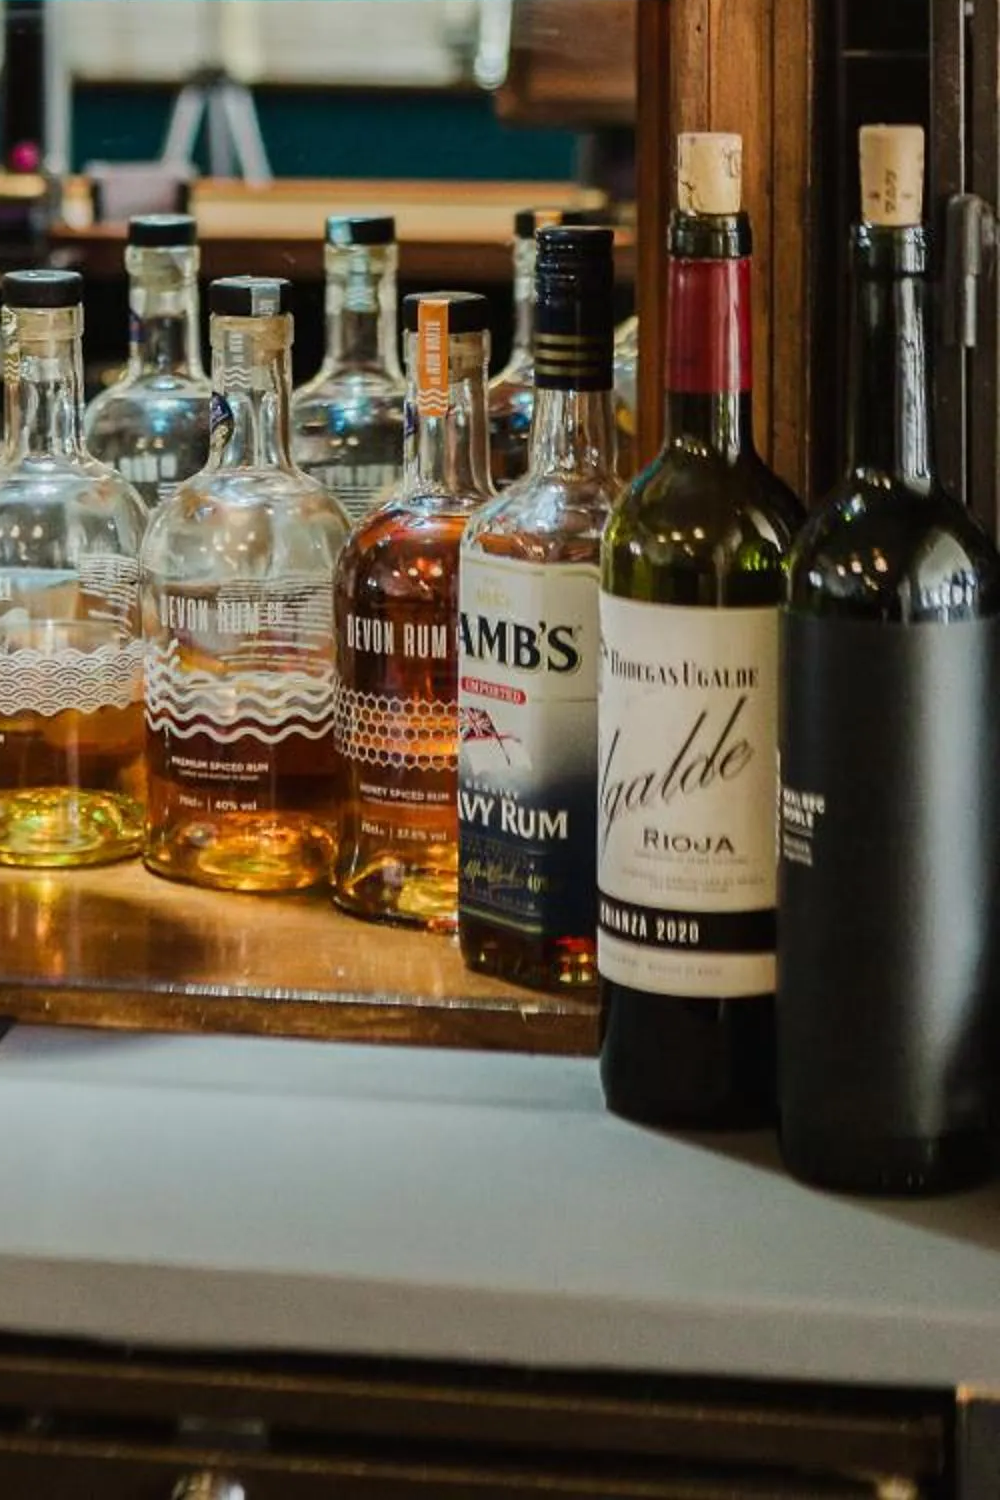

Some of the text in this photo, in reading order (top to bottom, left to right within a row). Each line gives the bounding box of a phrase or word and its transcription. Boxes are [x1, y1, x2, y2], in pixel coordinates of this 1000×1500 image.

[160, 595, 210, 632] DEVON
[347, 613, 448, 659] DEVON RUM
[459, 611, 579, 673] AMB'S
[209, 760, 244, 773] SPICED
[245, 762, 269, 773] RUM
[389, 788, 424, 801] SPICED
[457, 788, 495, 827] VY
[501, 798, 568, 841] RUM
[643, 827, 735, 854] RIOJA
[656, 917, 699, 943] 2020
